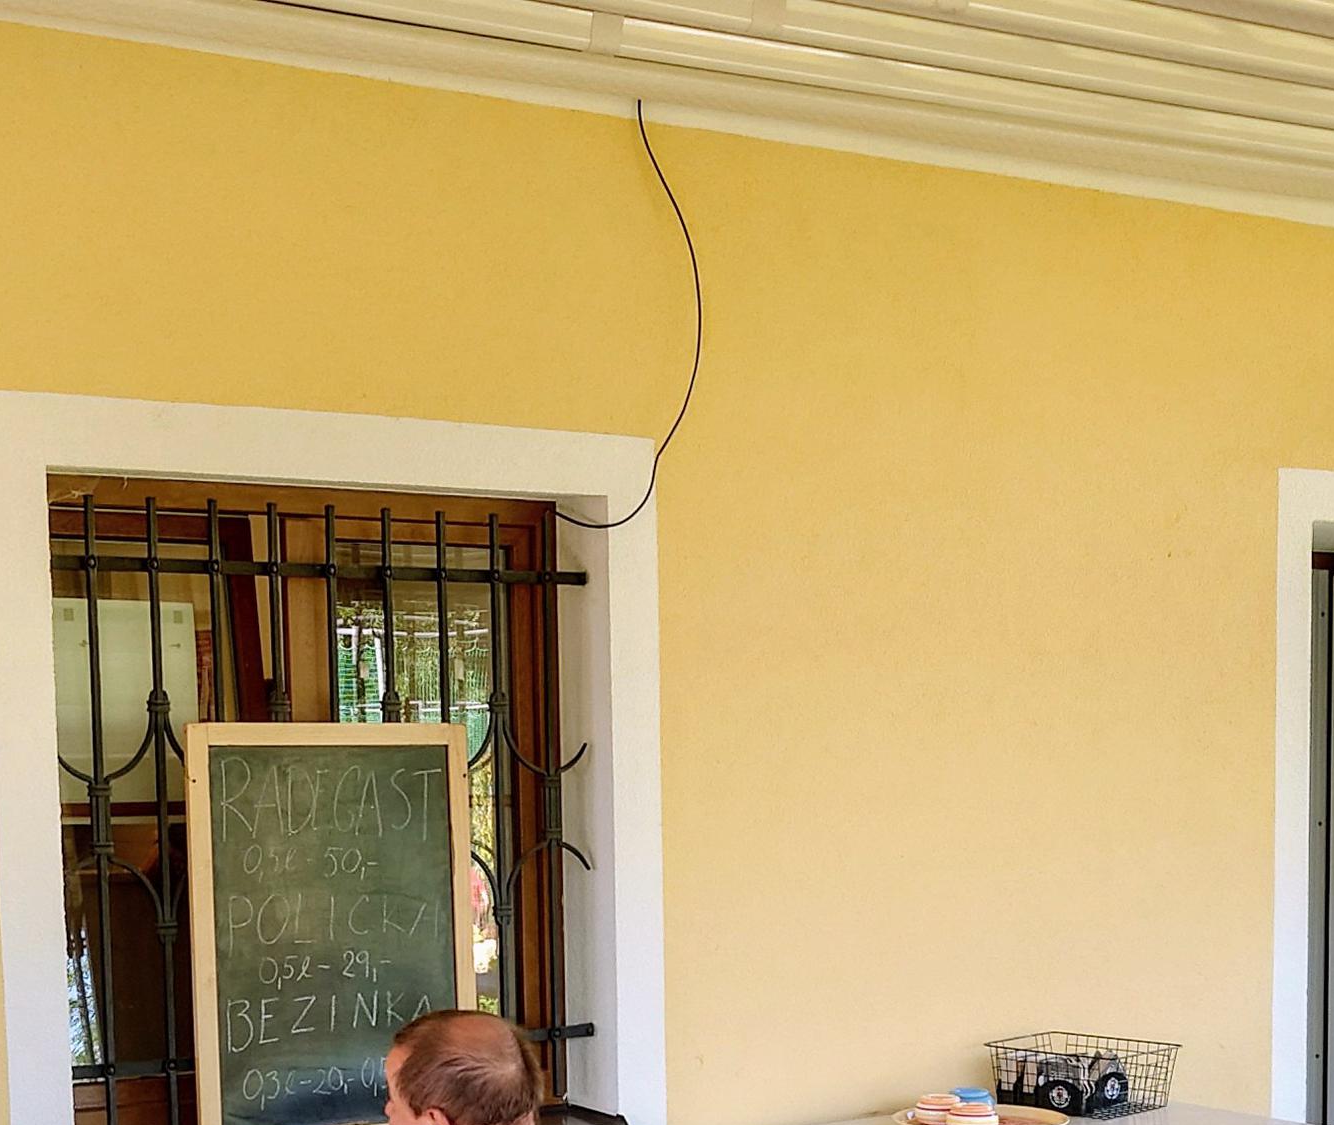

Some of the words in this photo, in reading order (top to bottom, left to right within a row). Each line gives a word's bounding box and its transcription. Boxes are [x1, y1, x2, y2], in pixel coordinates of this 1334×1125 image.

[220, 756, 443, 842] RADEGAST
[342, 949, 392, 983] 29,-
[226, 990, 433, 1054] BEZINKA
